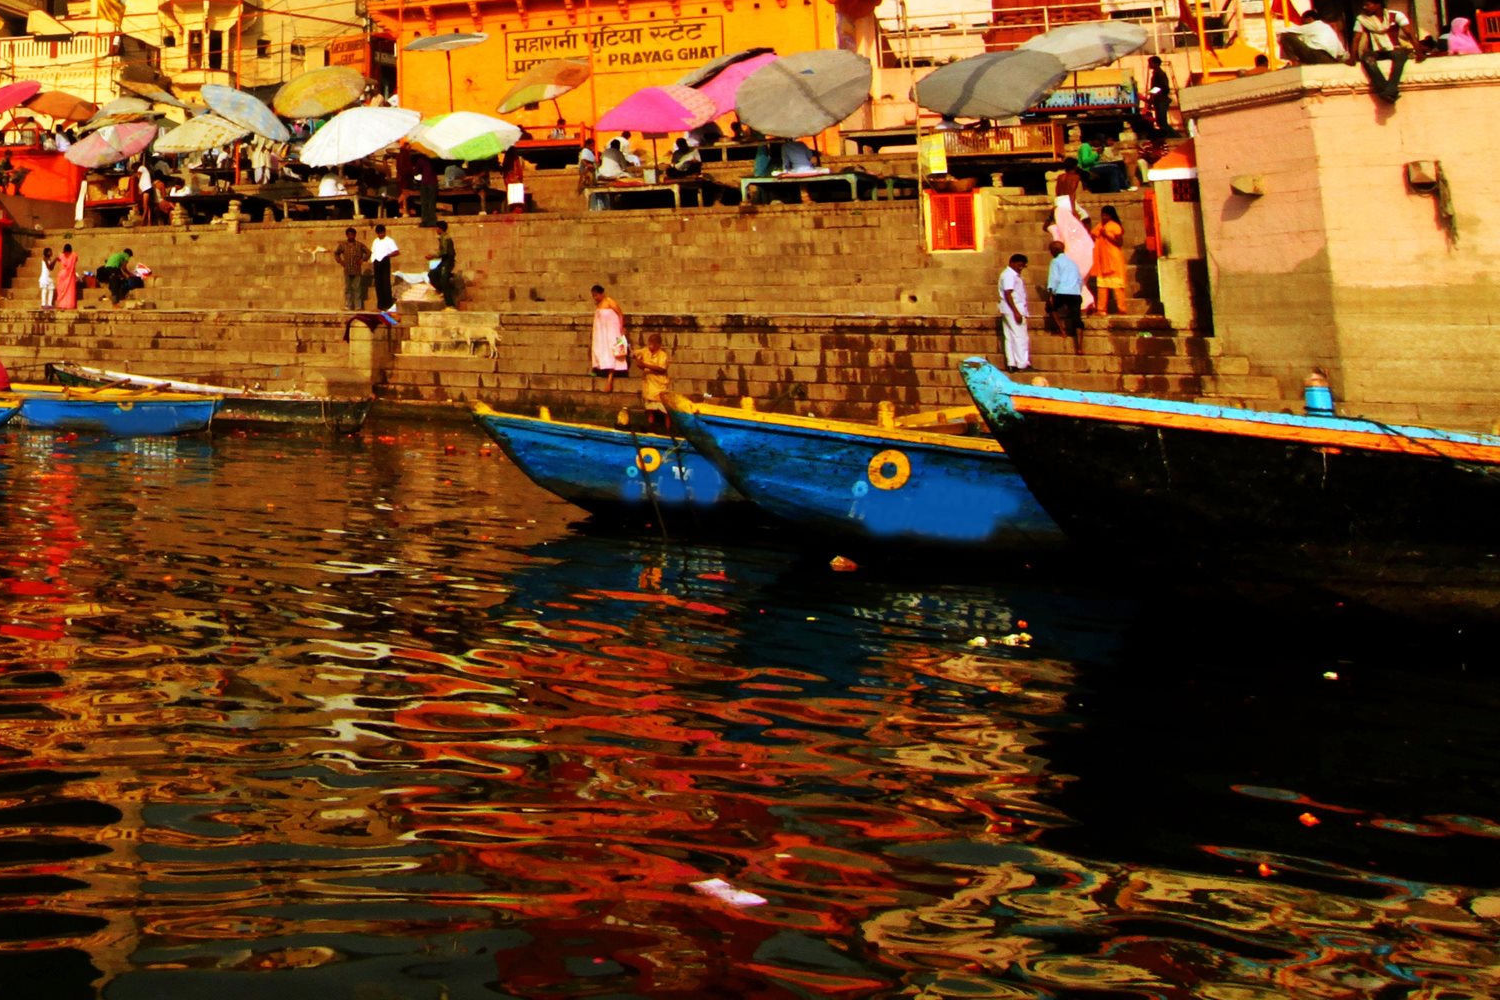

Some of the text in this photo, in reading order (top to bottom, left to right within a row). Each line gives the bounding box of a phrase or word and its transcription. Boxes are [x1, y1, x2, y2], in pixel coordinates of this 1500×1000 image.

[513, 29, 579, 53] महारानी
[649, 20, 706, 43] स्टेट
[608, 45, 718, 66] PRAYAG GHAT
